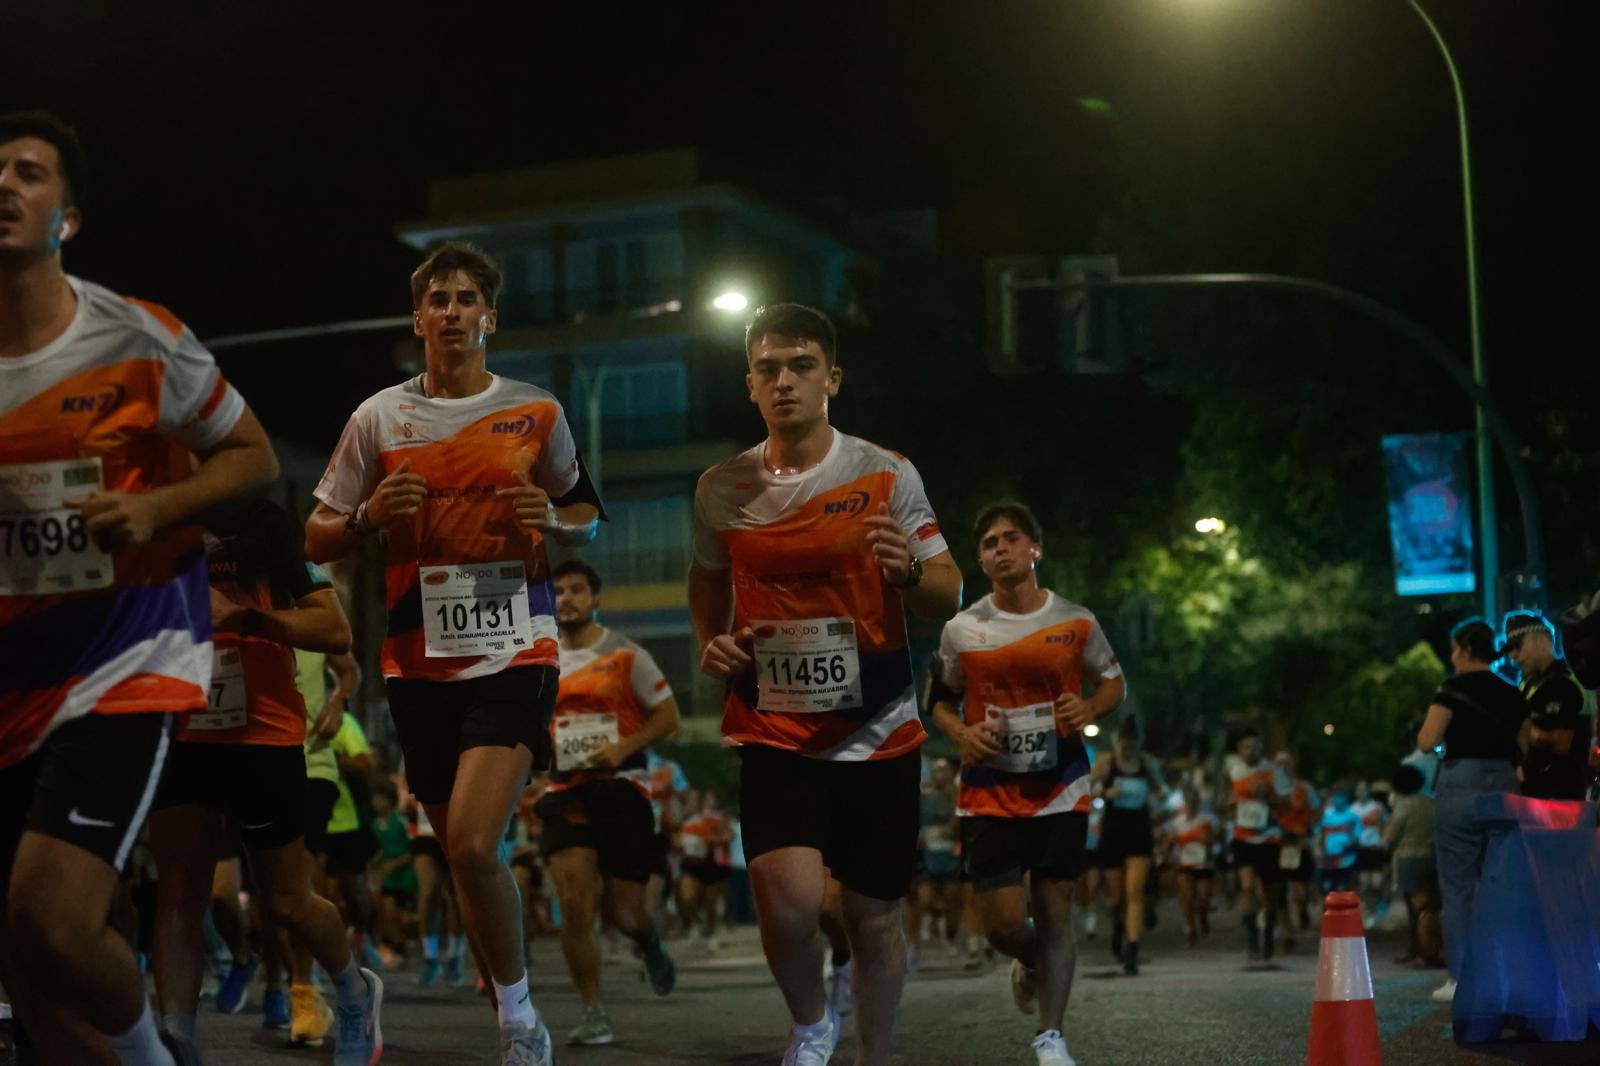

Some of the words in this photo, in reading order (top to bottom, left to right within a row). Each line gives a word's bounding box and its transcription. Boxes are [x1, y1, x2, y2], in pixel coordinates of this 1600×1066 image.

[62, 393, 112, 416] KH7
[491, 417, 526, 434] KH7
[824, 497, 860, 514] KH7
[0, 514, 88, 557] 7698
[437, 599, 514, 631] 10131
[767, 655, 846, 686] 11456
